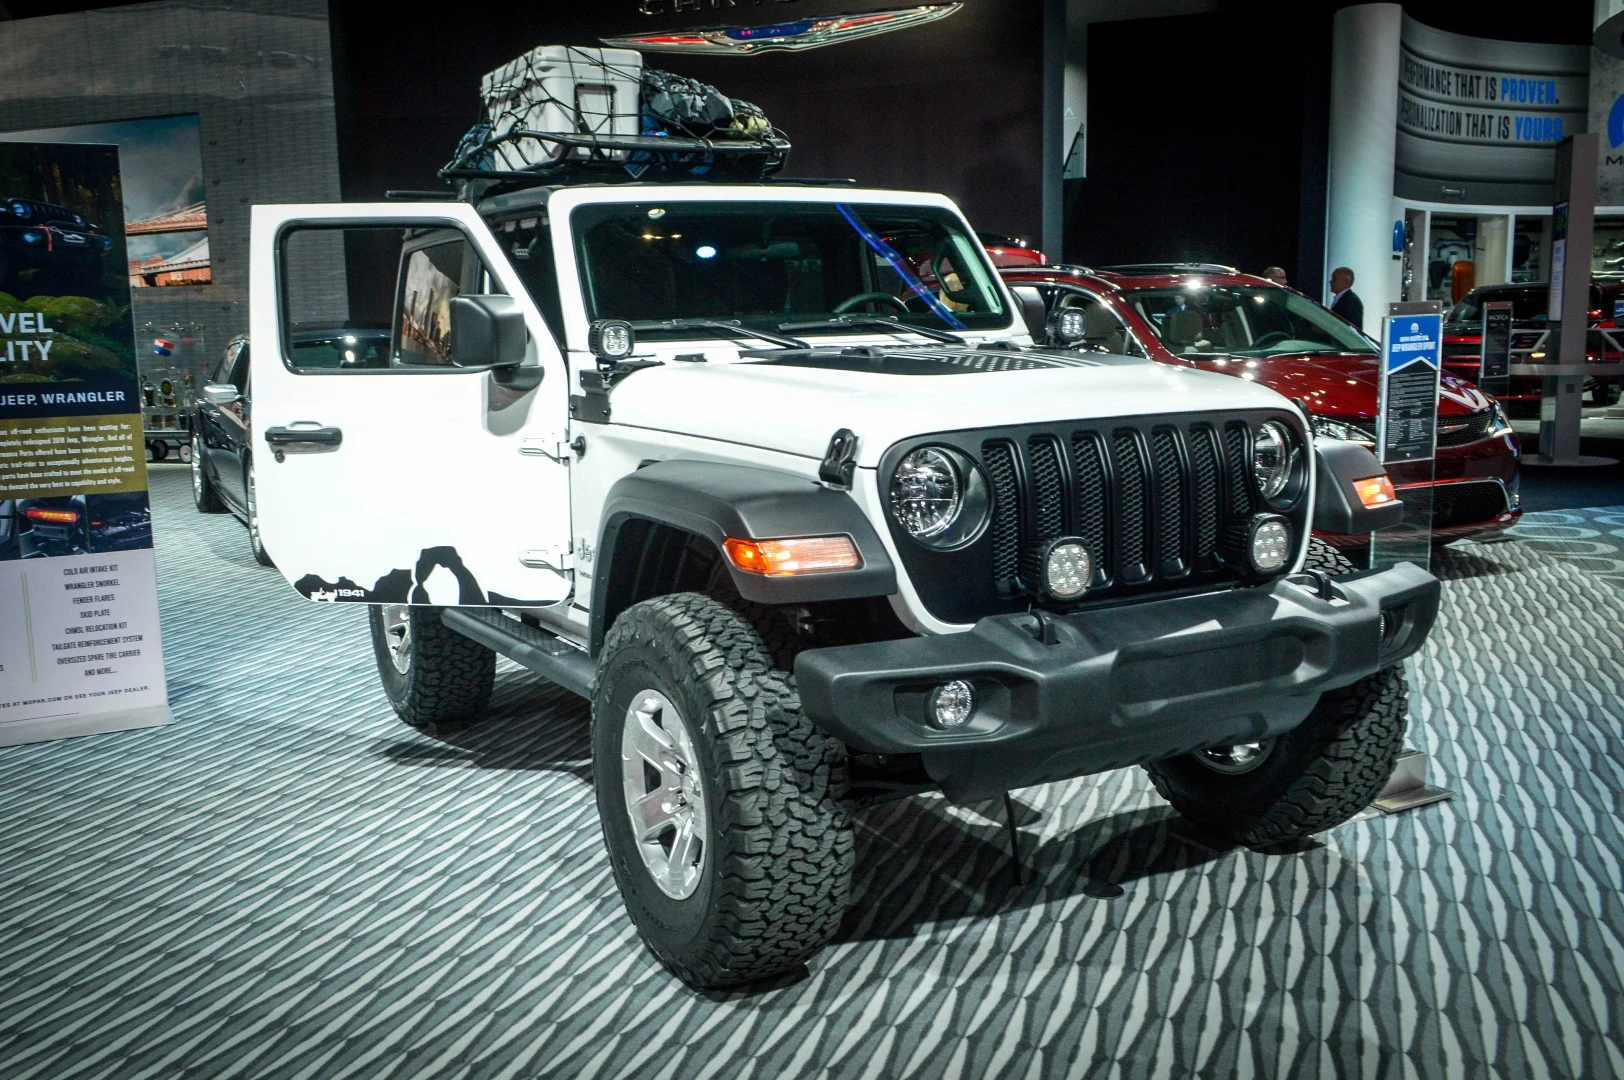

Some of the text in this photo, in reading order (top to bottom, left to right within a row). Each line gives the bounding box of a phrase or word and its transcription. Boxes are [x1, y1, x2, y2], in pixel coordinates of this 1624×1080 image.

[1454, 73, 1481, 100] THAT
[1485, 76, 1497, 100] IS
[1501, 77, 1560, 105] PROVEN.
[1466, 112, 1494, 138] THAT
[1498, 115, 1510, 139] IS
[1515, 116, 1563, 142] YOURS
[41, 391, 125, 404] WRANGLER
[63, 564, 118, 576] COLD AIR INTAKE KIT
[64, 579, 120, 590] WRANGLER SNORKEL
[72, 594, 115, 605] FENDER FLARES
[337, 589, 365, 598] 1941
[79, 608, 111, 618] SKID PLATE
[65, 621, 128, 635] CHMSL RELOCATION KIT
[51, 634, 143, 651] TAILGATE REINFORCEMENT SYSTEM
[57, 648, 141, 665] OVERSIZED SPARE TIRE CARRIER
[84, 668, 96, 677] AND
[23, 696, 62, 706] MOPAR.COM
